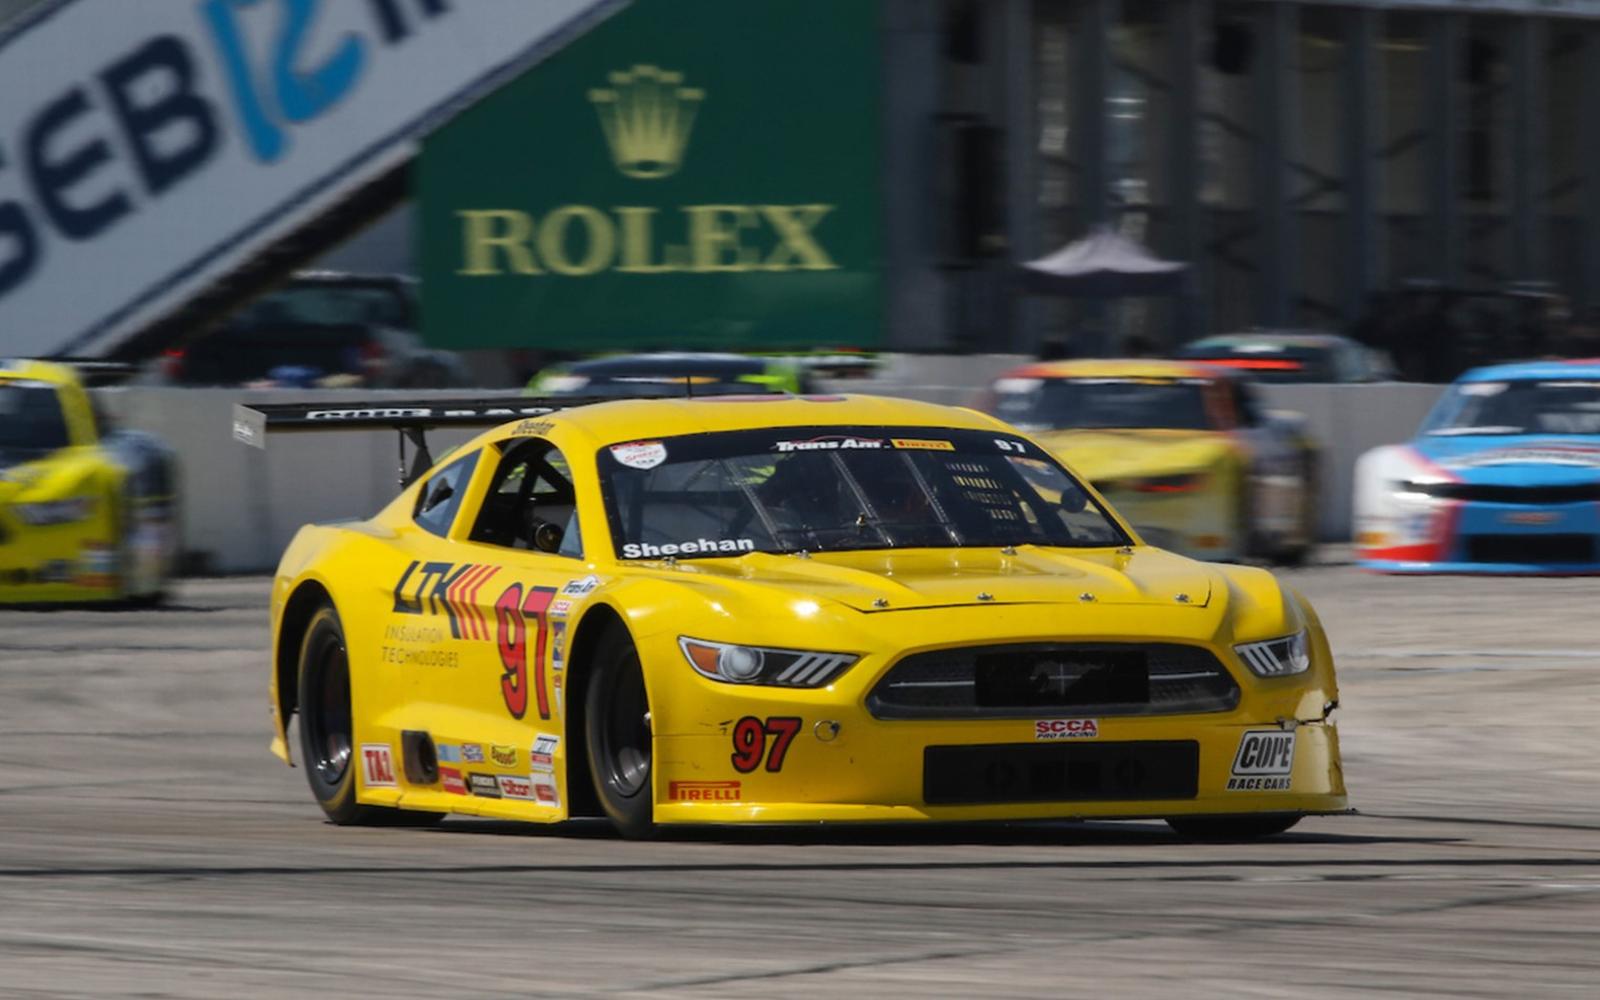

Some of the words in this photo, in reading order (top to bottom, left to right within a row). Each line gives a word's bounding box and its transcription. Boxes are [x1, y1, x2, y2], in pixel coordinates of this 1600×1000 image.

[454, 204, 838, 276] ROLEX
[776, 441, 839, 452] Trans
[840, 439, 881, 449] Am
[993, 439, 1026, 453] 97
[623, 538, 754, 558] Sheehan
[393, 560, 474, 639] LTK
[495, 582, 558, 720] 97
[1036, 720, 1097, 733] SCCA
[731, 715, 802, 773] 97
[1240, 736, 1292, 768] COPE
[669, 781, 741, 800] PIRELLI
[1227, 778, 1262, 789] RACE
[1263, 778, 1291, 789] CARS
